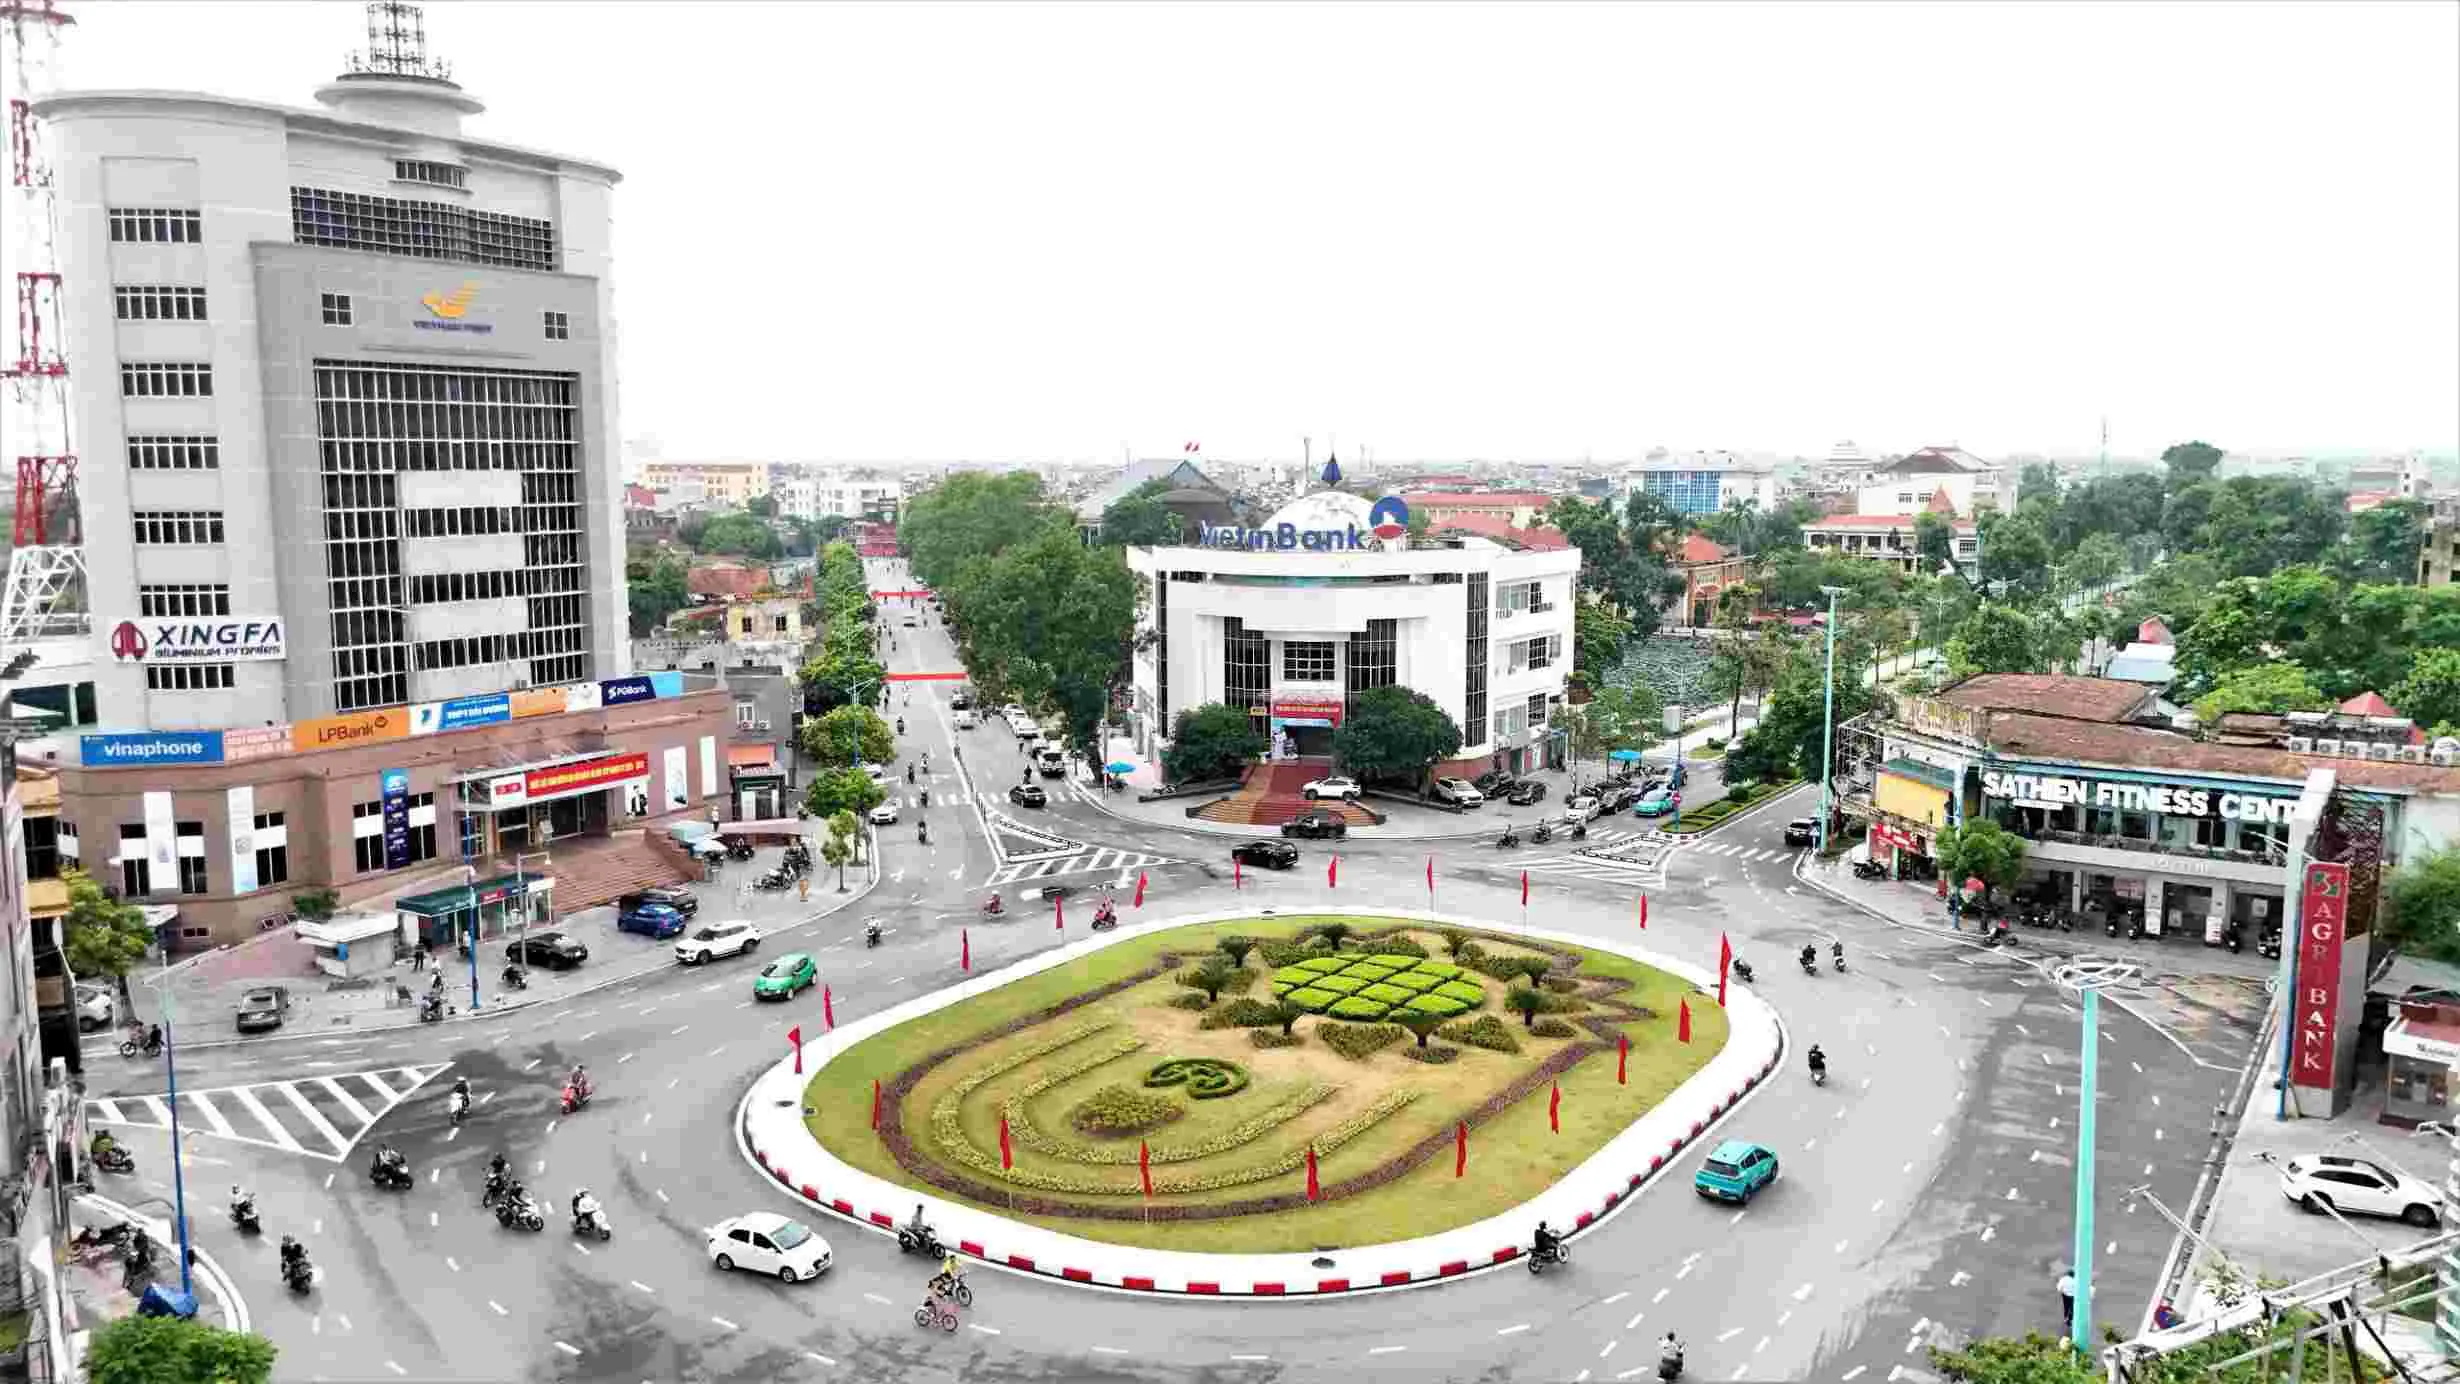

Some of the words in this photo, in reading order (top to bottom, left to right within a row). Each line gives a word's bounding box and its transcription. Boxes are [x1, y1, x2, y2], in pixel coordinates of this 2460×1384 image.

[1200, 519, 1367, 550] VietinBank
[155, 623, 280, 645] XINGFA
[318, 724, 374, 744] LPBank
[104, 741, 203, 758] vinaphone
[1982, 771, 2087, 805] SATHEN
[2096, 782, 2209, 817] FITNESS
[2218, 793, 2298, 824] CENT
